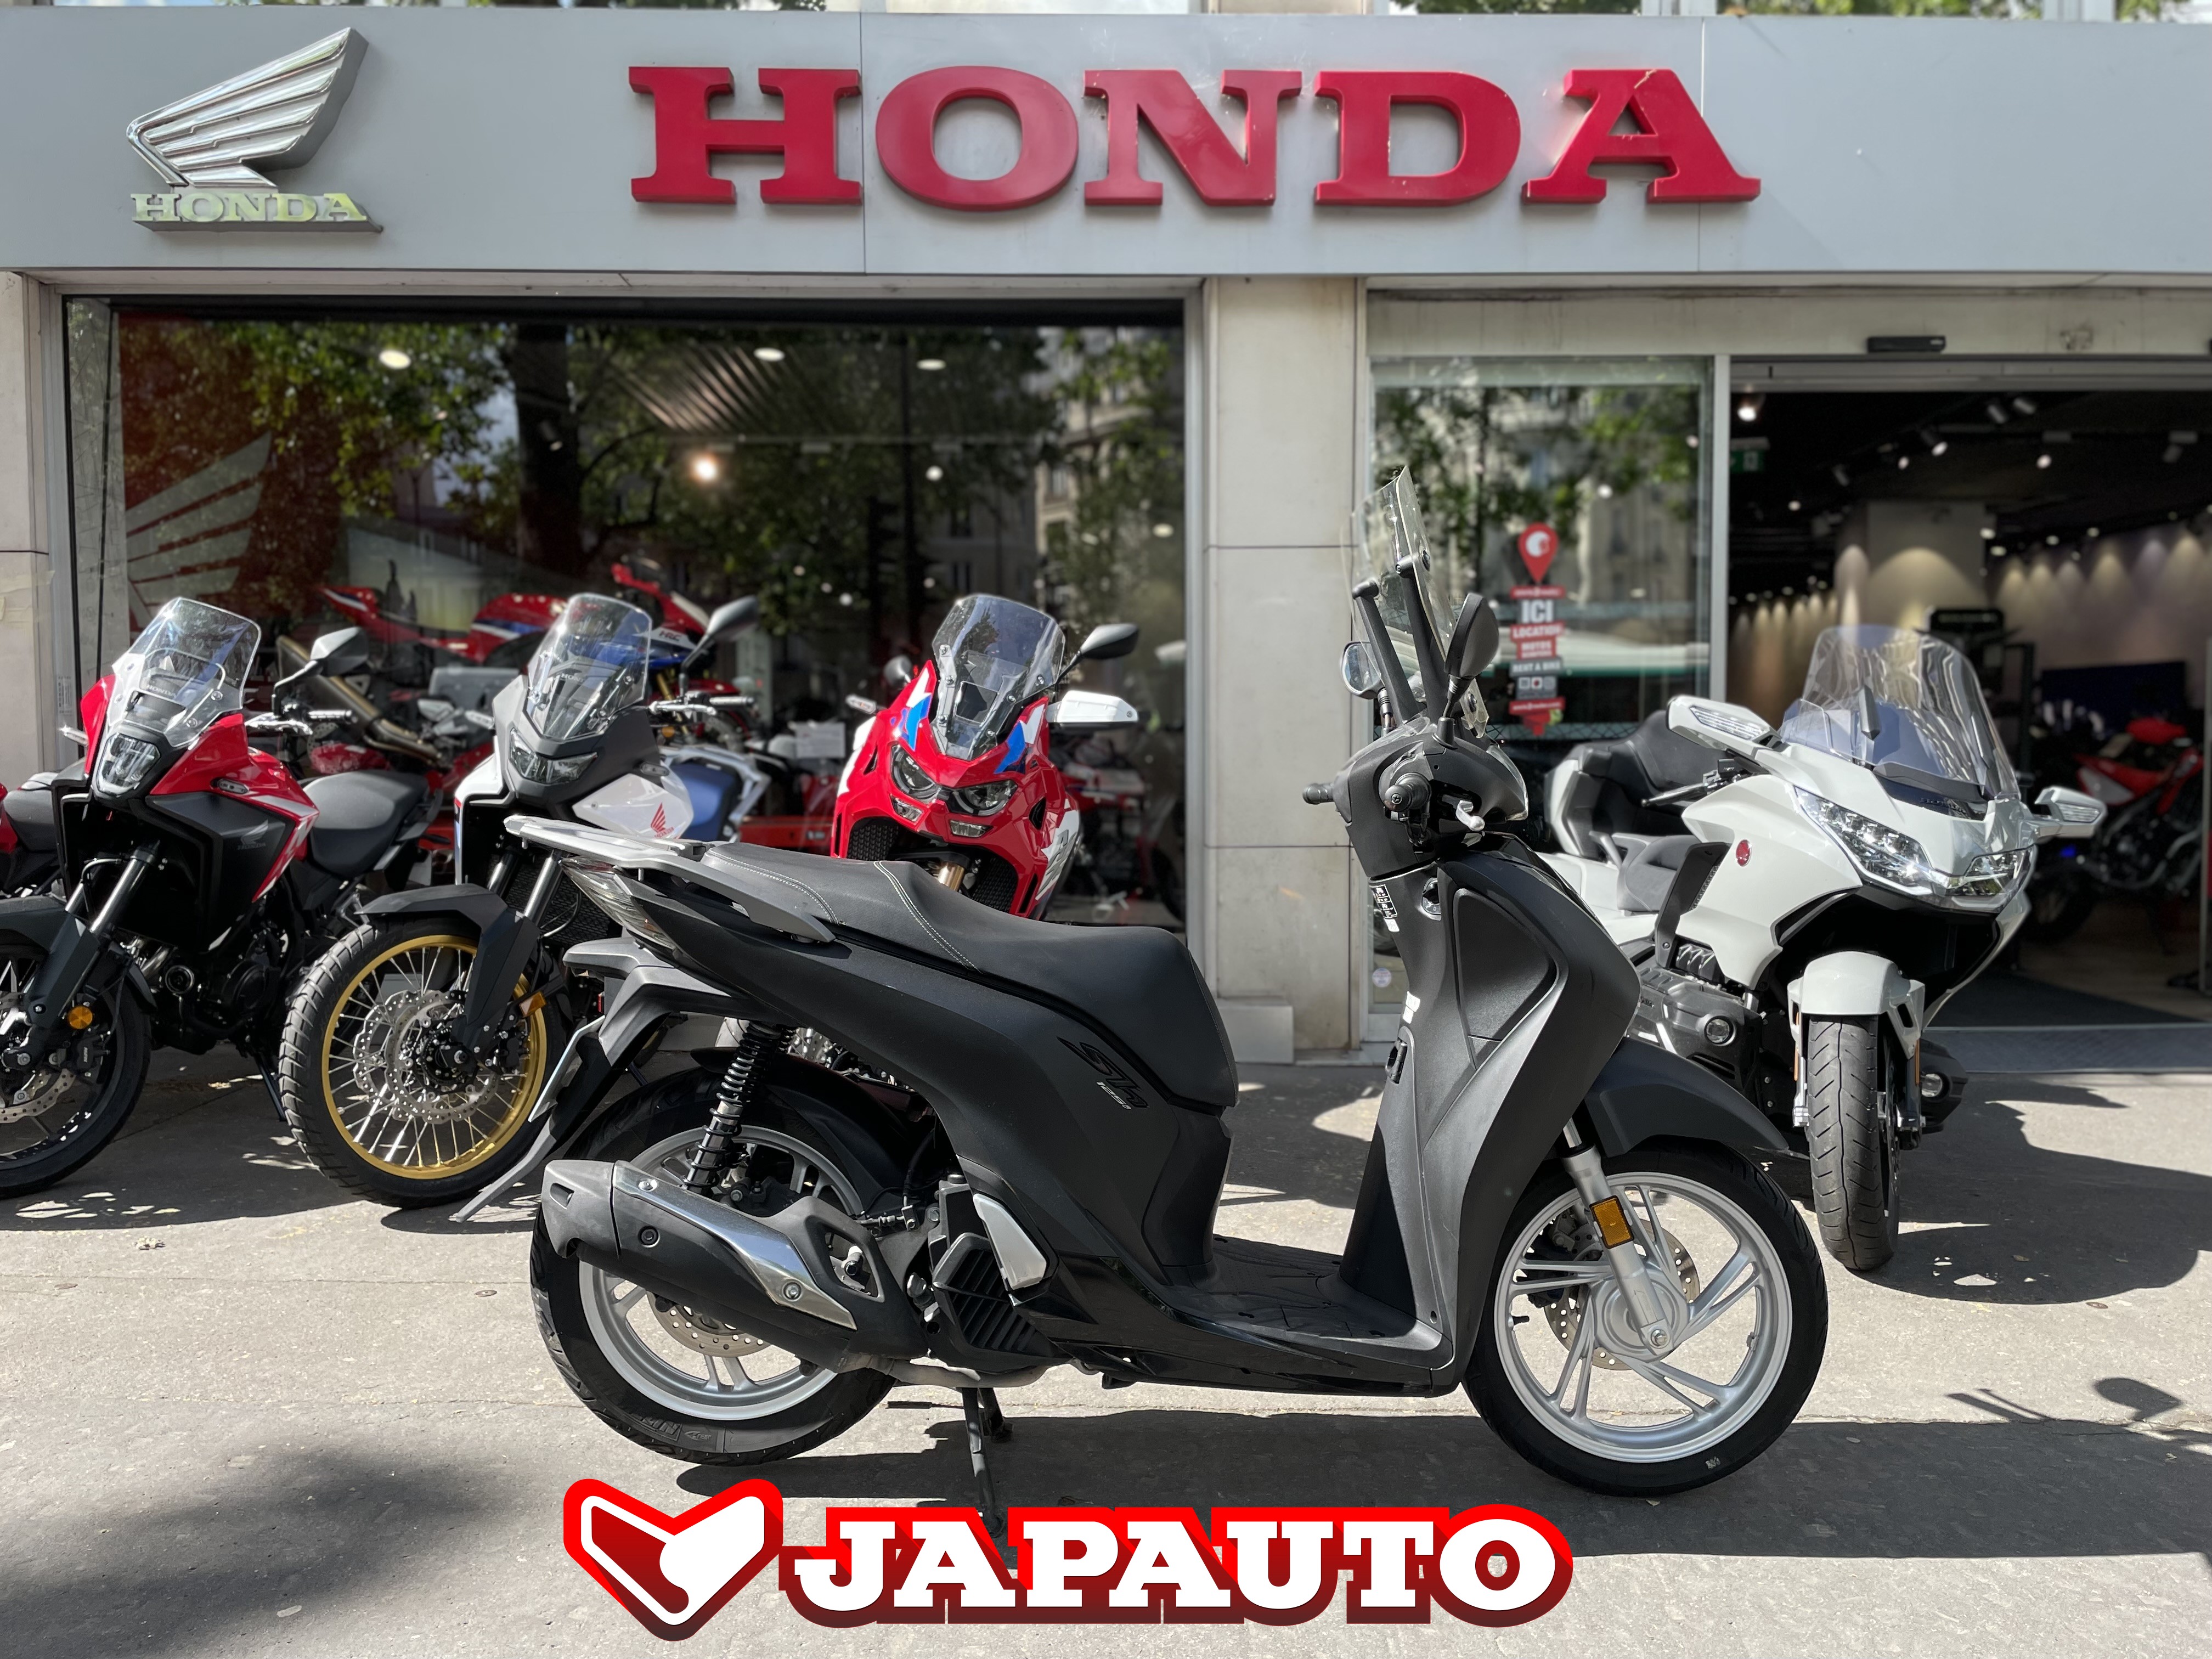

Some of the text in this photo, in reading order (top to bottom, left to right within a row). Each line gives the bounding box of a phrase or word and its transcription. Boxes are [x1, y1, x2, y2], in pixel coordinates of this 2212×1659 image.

[629, 65, 1762, 212] HONDA
[131, 193, 366, 222] HONDA
[1522, 600, 1554, 623] ICI
[659, 630, 682, 641] HRC
[1513, 624, 1561, 639] LOCATION
[1534, 662, 1541, 671] A
